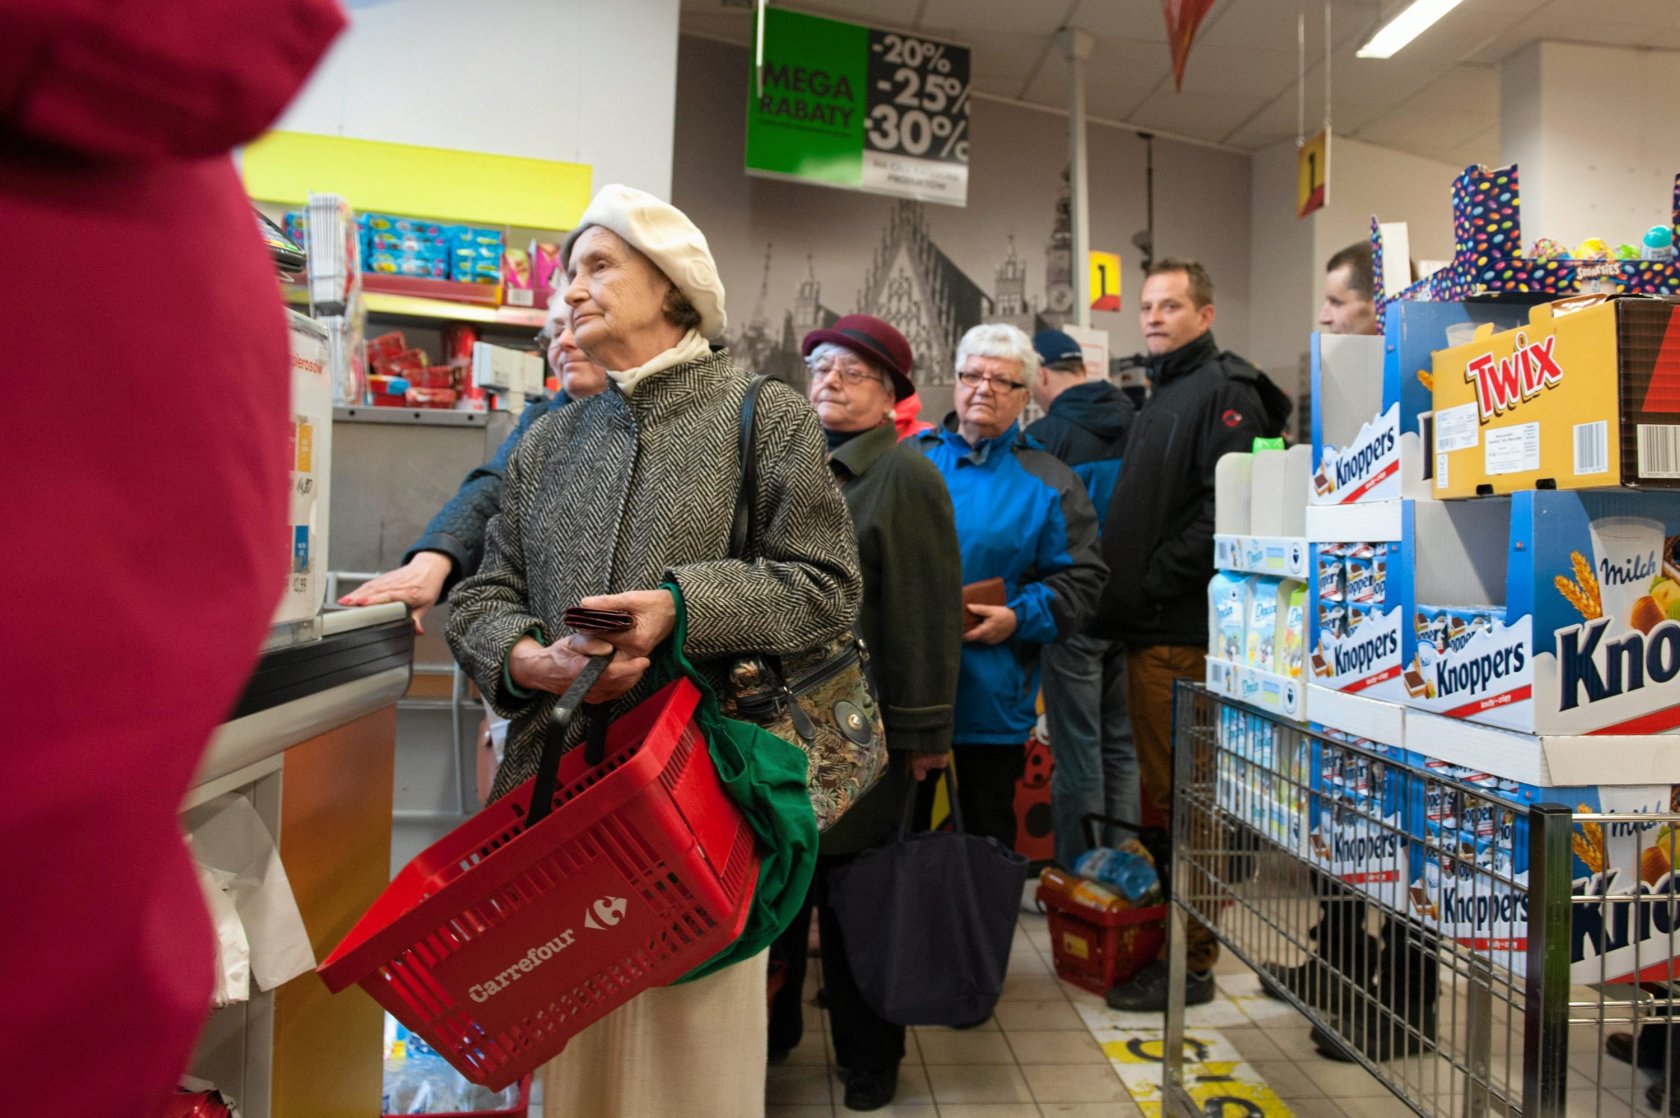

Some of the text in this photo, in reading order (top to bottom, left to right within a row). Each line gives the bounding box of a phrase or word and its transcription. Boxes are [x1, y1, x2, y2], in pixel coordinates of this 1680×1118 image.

[871, 34, 951, 73] -20%
[762, 63, 854, 101] MEGA
[877, 67, 970, 114] -25%
[760, 93, 855, 128] RABATY
[863, 103, 969, 161] -30%
[1308, 152, 1316, 194] 1
[1097, 263, 1106, 297] 1
[1336, 426, 1395, 490] Knoppers
[1334, 628, 1397, 677] Knoppers
[1437, 641, 1525, 698] Knoppers
[1557, 617, 1680, 712] Kno
[1334, 832, 1396, 868] Knoppers
[1444, 887, 1529, 931] Knoppers
[468, 928, 576, 1003] Carrefour
